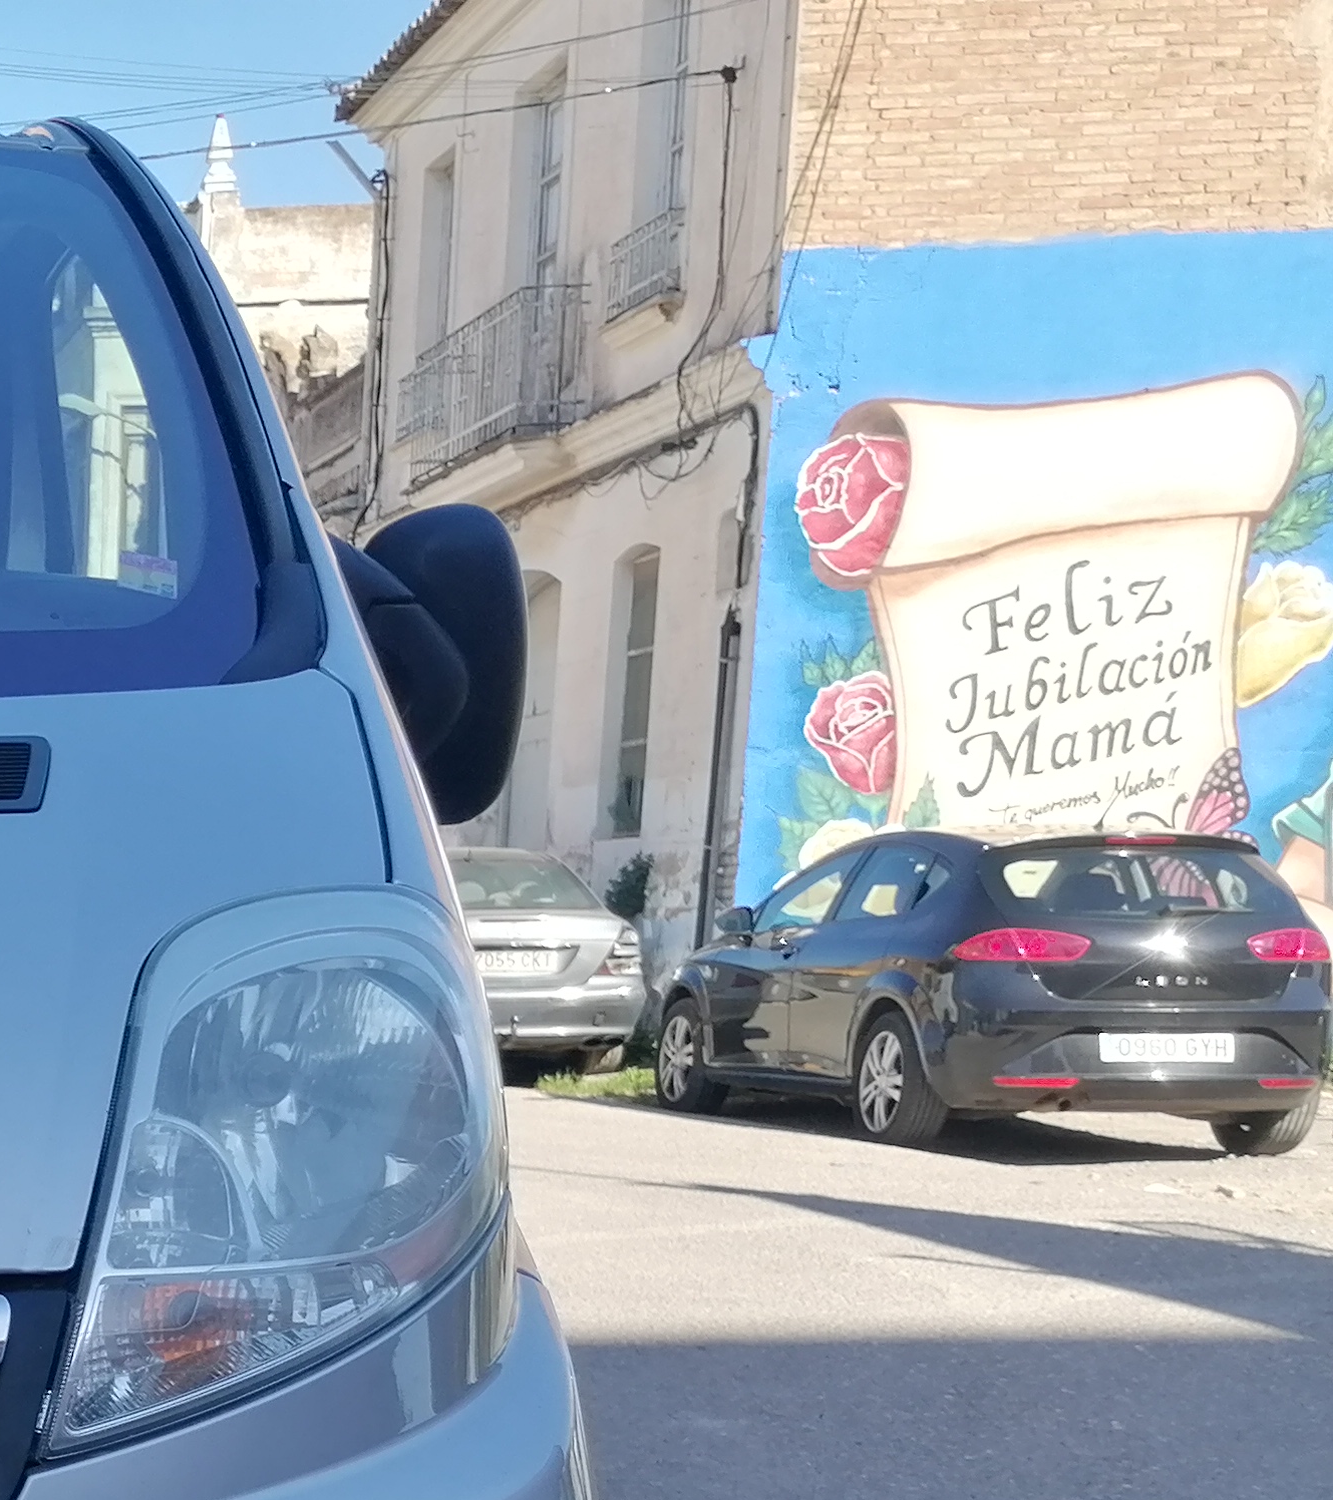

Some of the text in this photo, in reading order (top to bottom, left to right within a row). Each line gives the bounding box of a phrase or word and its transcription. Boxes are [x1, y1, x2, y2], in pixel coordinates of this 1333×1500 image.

[962, 560, 1173, 655] Feliz
[945, 631, 1213, 734] Jubilación
[956, 692, 1183, 799] Mamá
[1024, 790, 1102, 822] queremos
[1185, 1037, 1228, 1058] GYH
